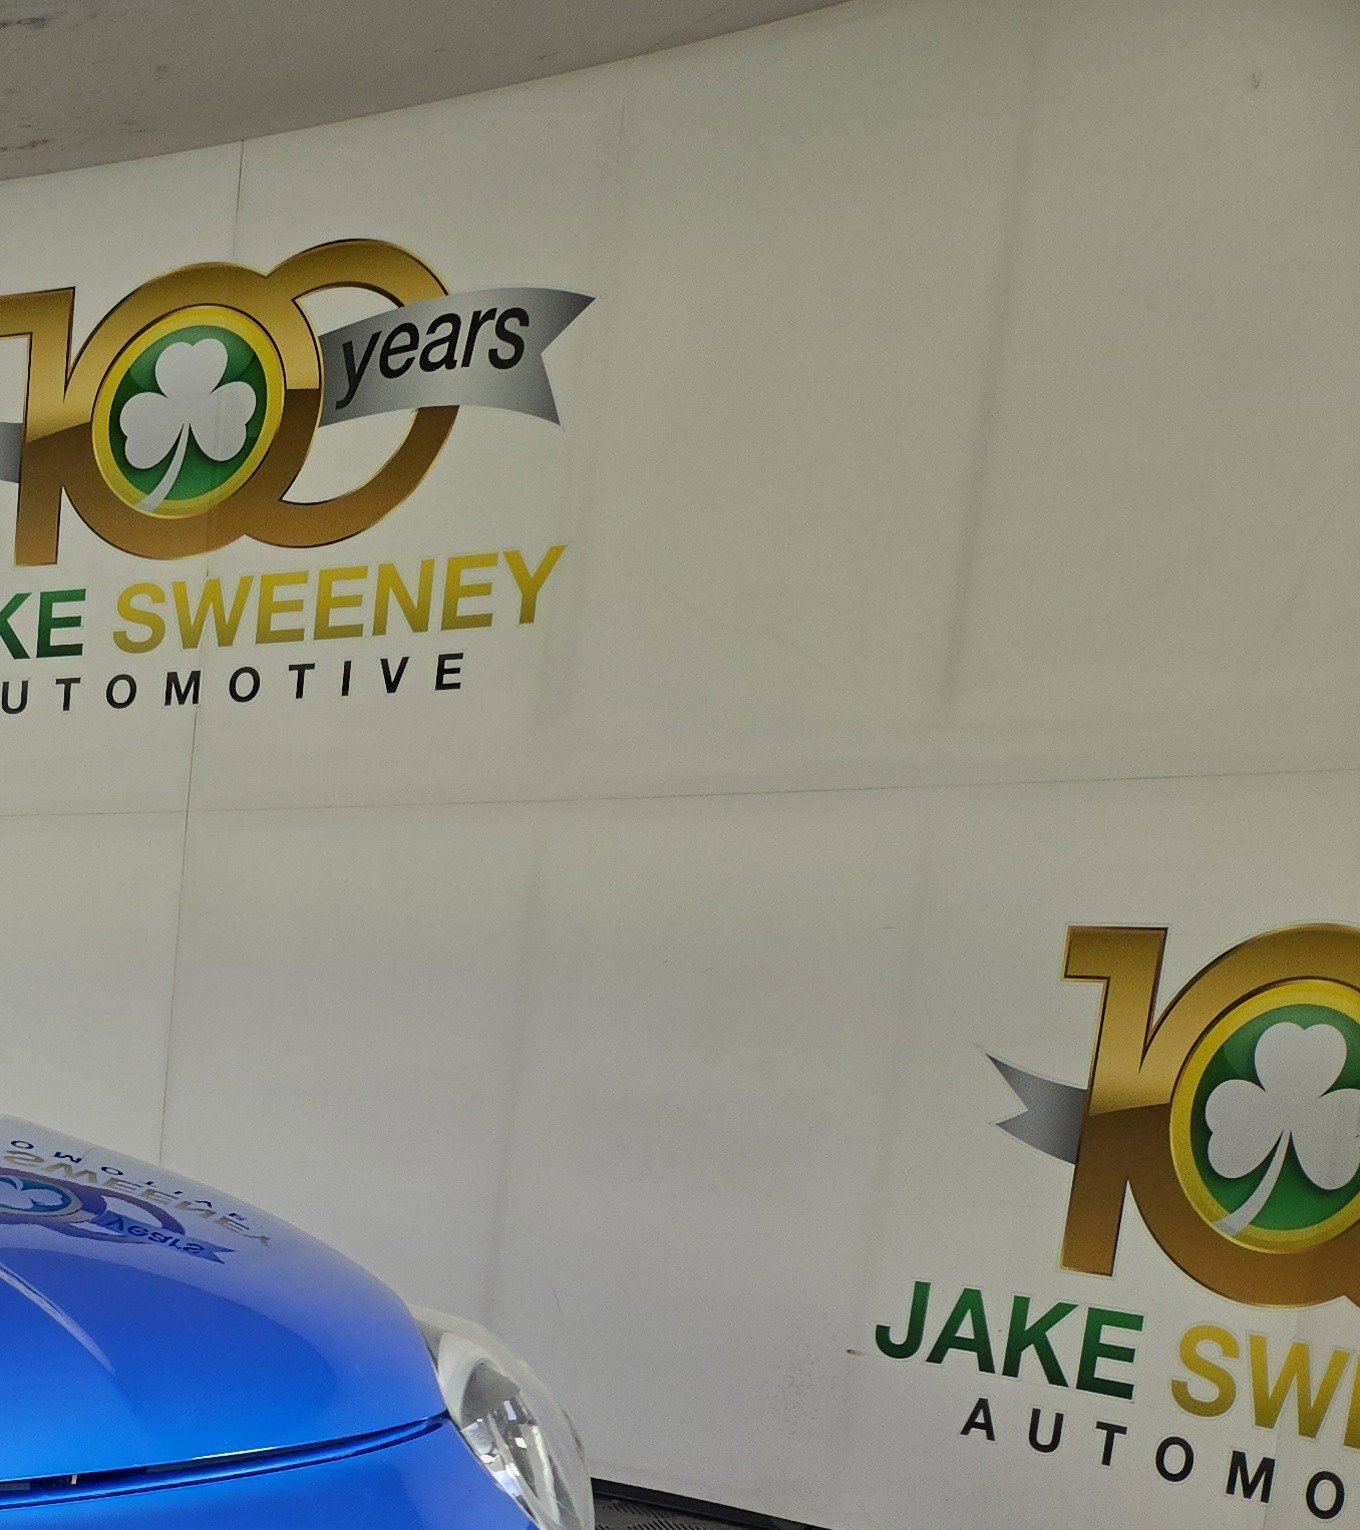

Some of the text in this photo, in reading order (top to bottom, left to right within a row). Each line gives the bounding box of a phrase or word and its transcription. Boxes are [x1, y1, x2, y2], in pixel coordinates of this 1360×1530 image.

[336, 305, 529, 411] years
[112, 545, 567, 654] SWEENEY
[875, 1281, 1360, 1450] JAKE SW
[960, 1397, 1345, 1520] AUTOMO
